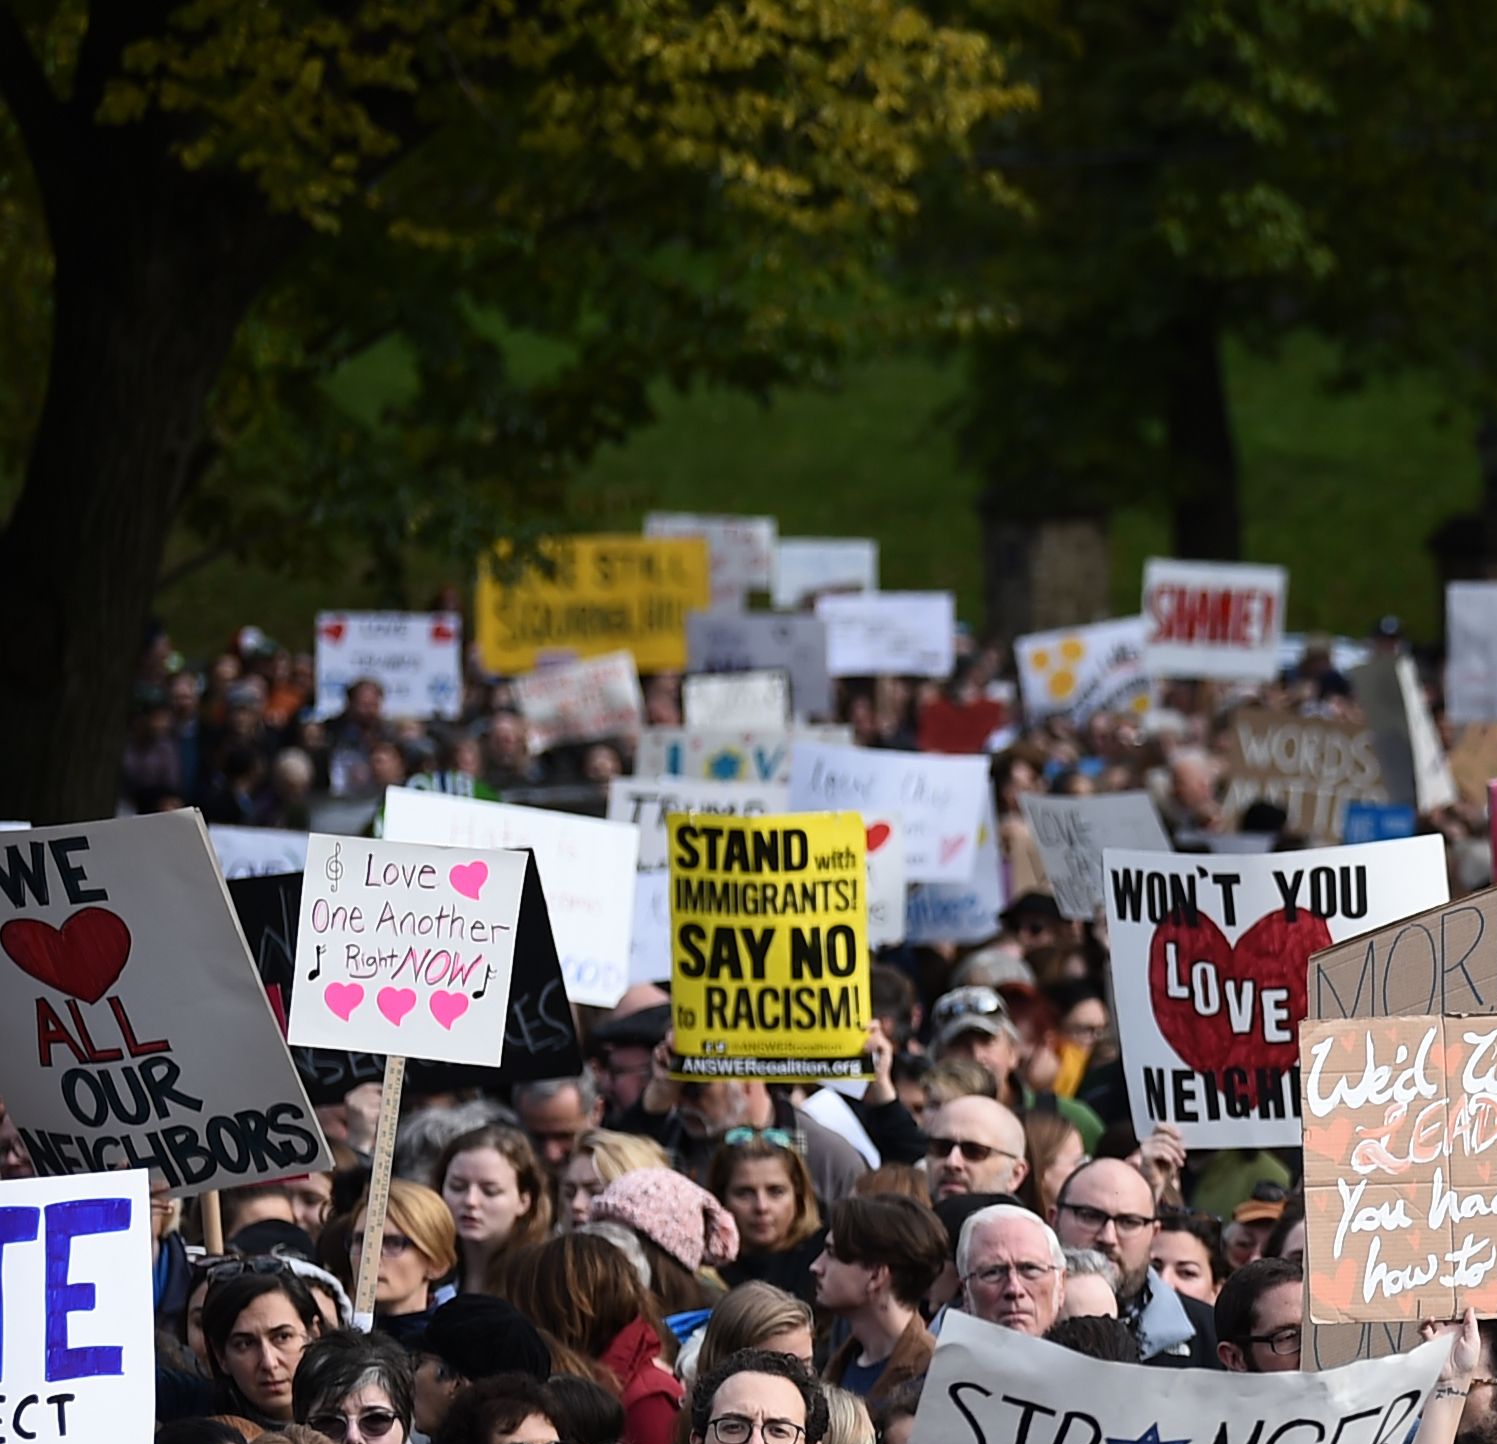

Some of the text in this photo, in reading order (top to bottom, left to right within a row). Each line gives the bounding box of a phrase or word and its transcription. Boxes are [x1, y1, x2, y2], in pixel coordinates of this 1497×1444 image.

[1236, 721, 1384, 793] WORDS
[0, 835, 108, 910] WE
[364, 853, 437, 889] Love
[676, 828, 856, 873] STAND with
[311, 898, 510, 944] One Another
[674, 879, 858, 917] IMMIGRANTS!
[1110, 865, 1368, 928] WON'T YOU
[345, 944, 484, 988] Right NOW
[678, 924, 775, 979] SAY
[790, 924, 857, 979] NO
[677, 985, 865, 1033] to RACISM!
[1165, 941, 1292, 1044] LOVE
[35, 996, 172, 1067] ALL
[60, 1060, 204, 1128] OUR
[1142, 1065, 1300, 1123] NEIGH
[1307, 1026, 1439, 1119] We'd
[18, 1103, 320, 1191] NEIGHBORS
[1336, 1176, 1412, 1259] You
[1364, 1237, 1439, 1305] how
[1439, 1227, 1497, 1288] to
